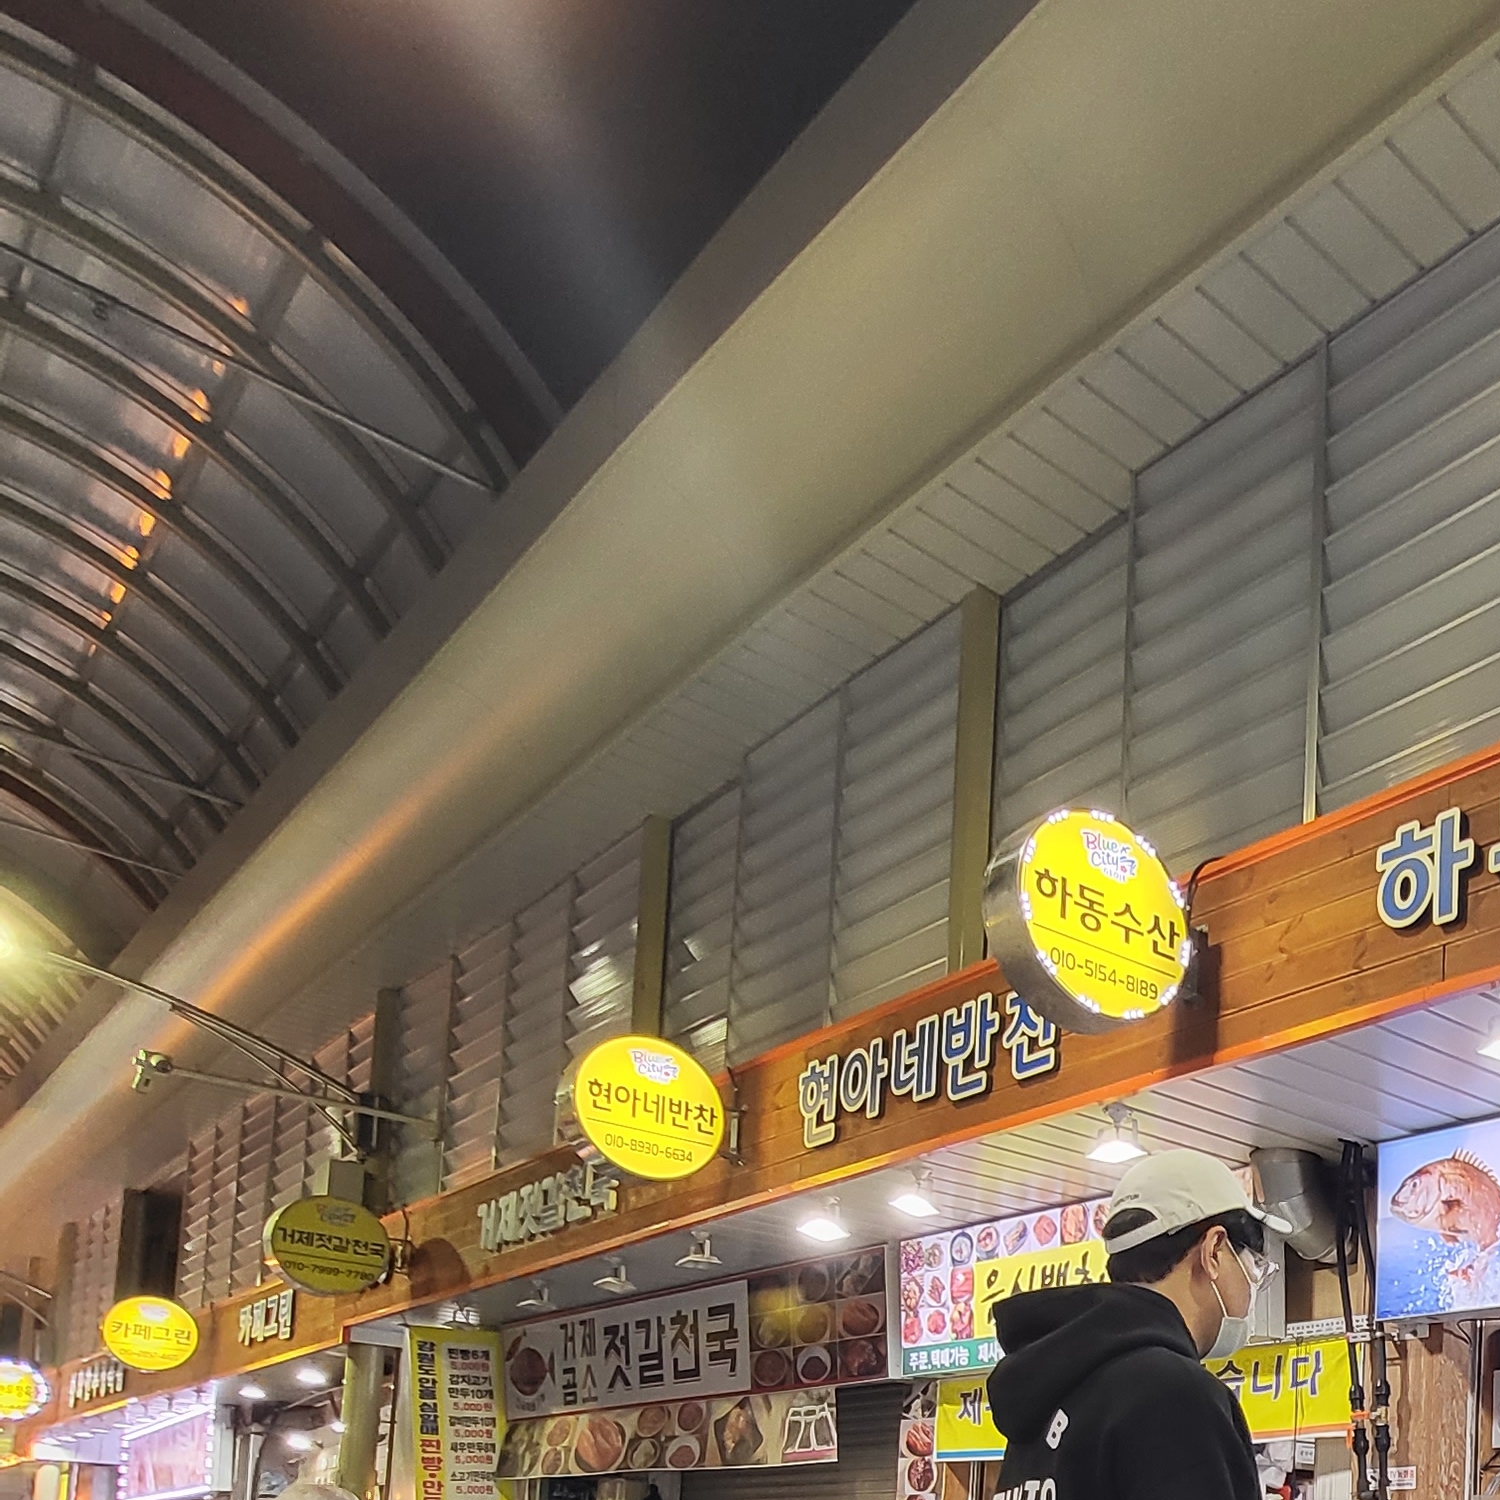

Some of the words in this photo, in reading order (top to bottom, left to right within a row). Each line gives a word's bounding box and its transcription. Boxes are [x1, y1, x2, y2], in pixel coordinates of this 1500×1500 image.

[1083, 832, 1120, 853] Blue
[1092, 850, 1119, 871] City
[1034, 868, 1181, 962] 하동수산
[1050, 947, 1158, 1000] 010-5154-8189
[799, 992, 1055, 1148] 현아네반찬
[588, 1078, 718, 1136] 현아네반찬
[278, 1227, 385, 1259] 거제젓갈천국
[110, 1320, 192, 1347] 카페그린
[238, 1289, 294, 1347] 카페그린
[560, 1317, 597, 1361] 거제
[604, 1303, 739, 1392] 젓갈천국
[448, 1387, 494, 1400] 만두10개
[562, 1364, 599, 1406] 곰소
